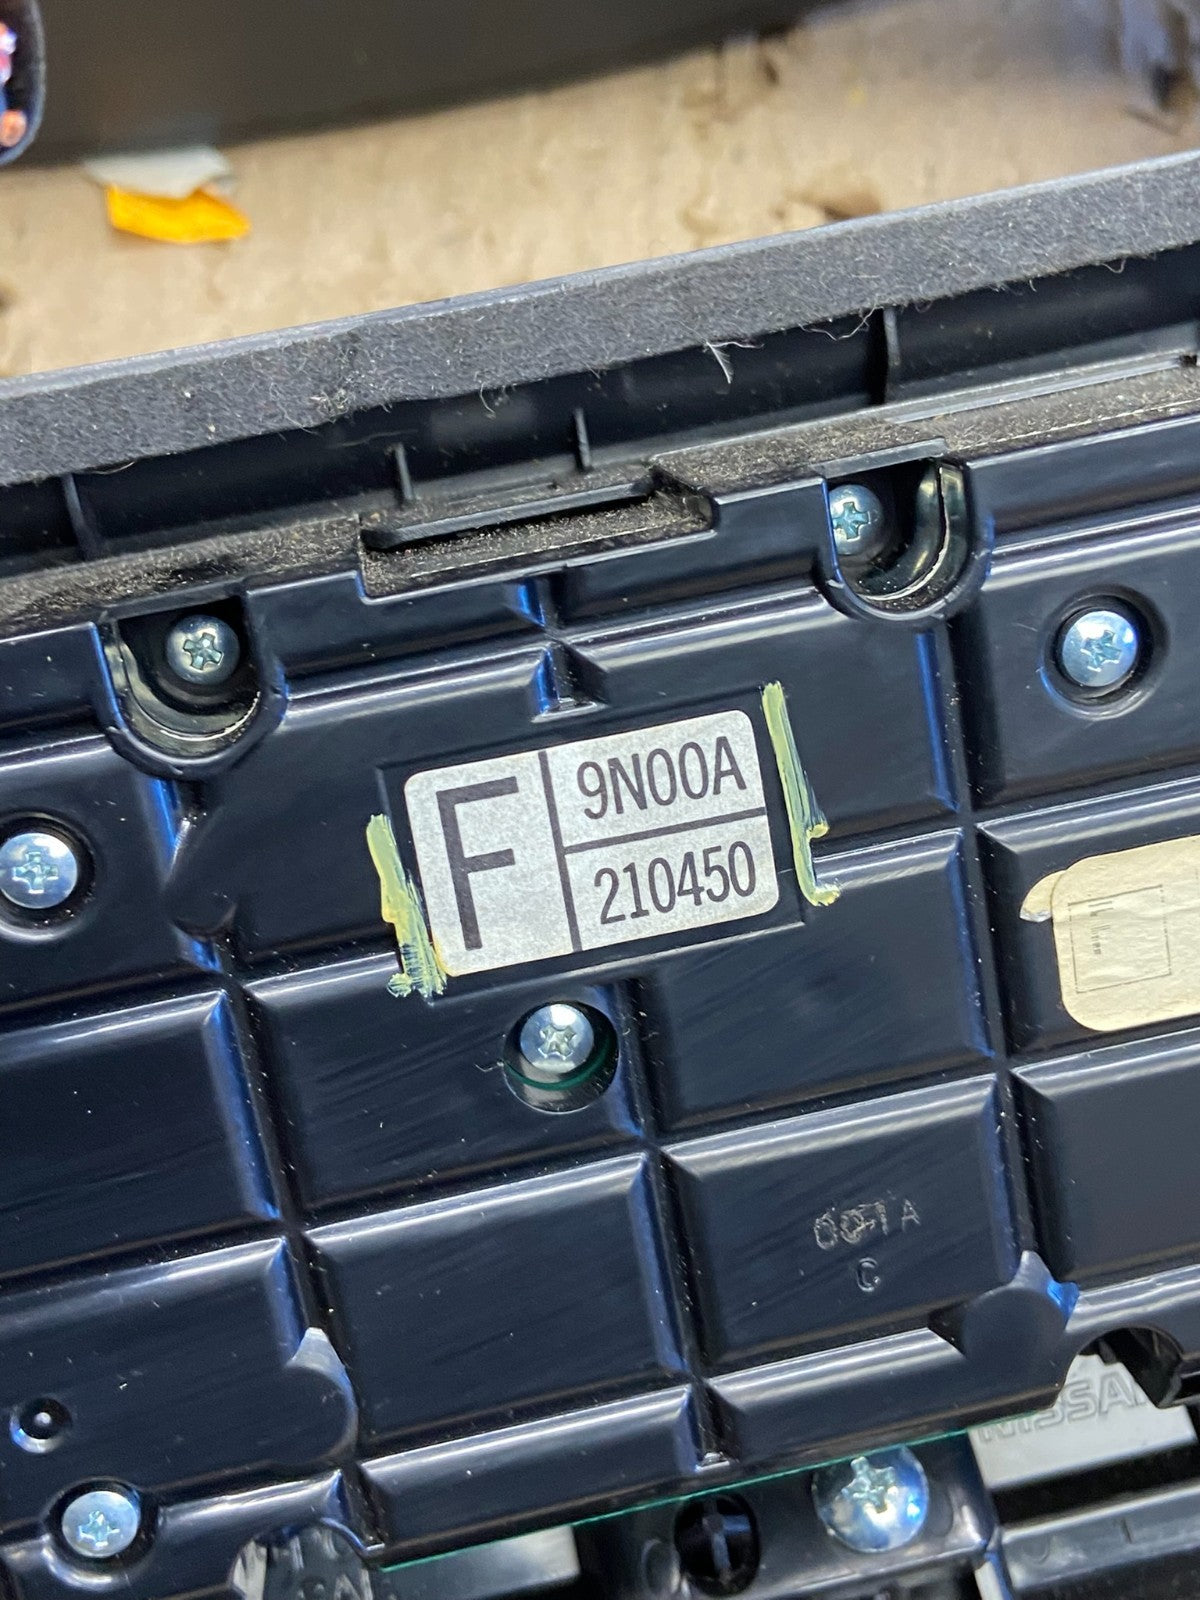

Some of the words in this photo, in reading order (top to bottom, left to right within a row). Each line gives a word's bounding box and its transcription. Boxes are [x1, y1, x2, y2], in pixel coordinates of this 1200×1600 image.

[576, 736, 747, 819] 9N00A
[436, 776, 519, 951] F
[594, 841, 755, 925] 210450
